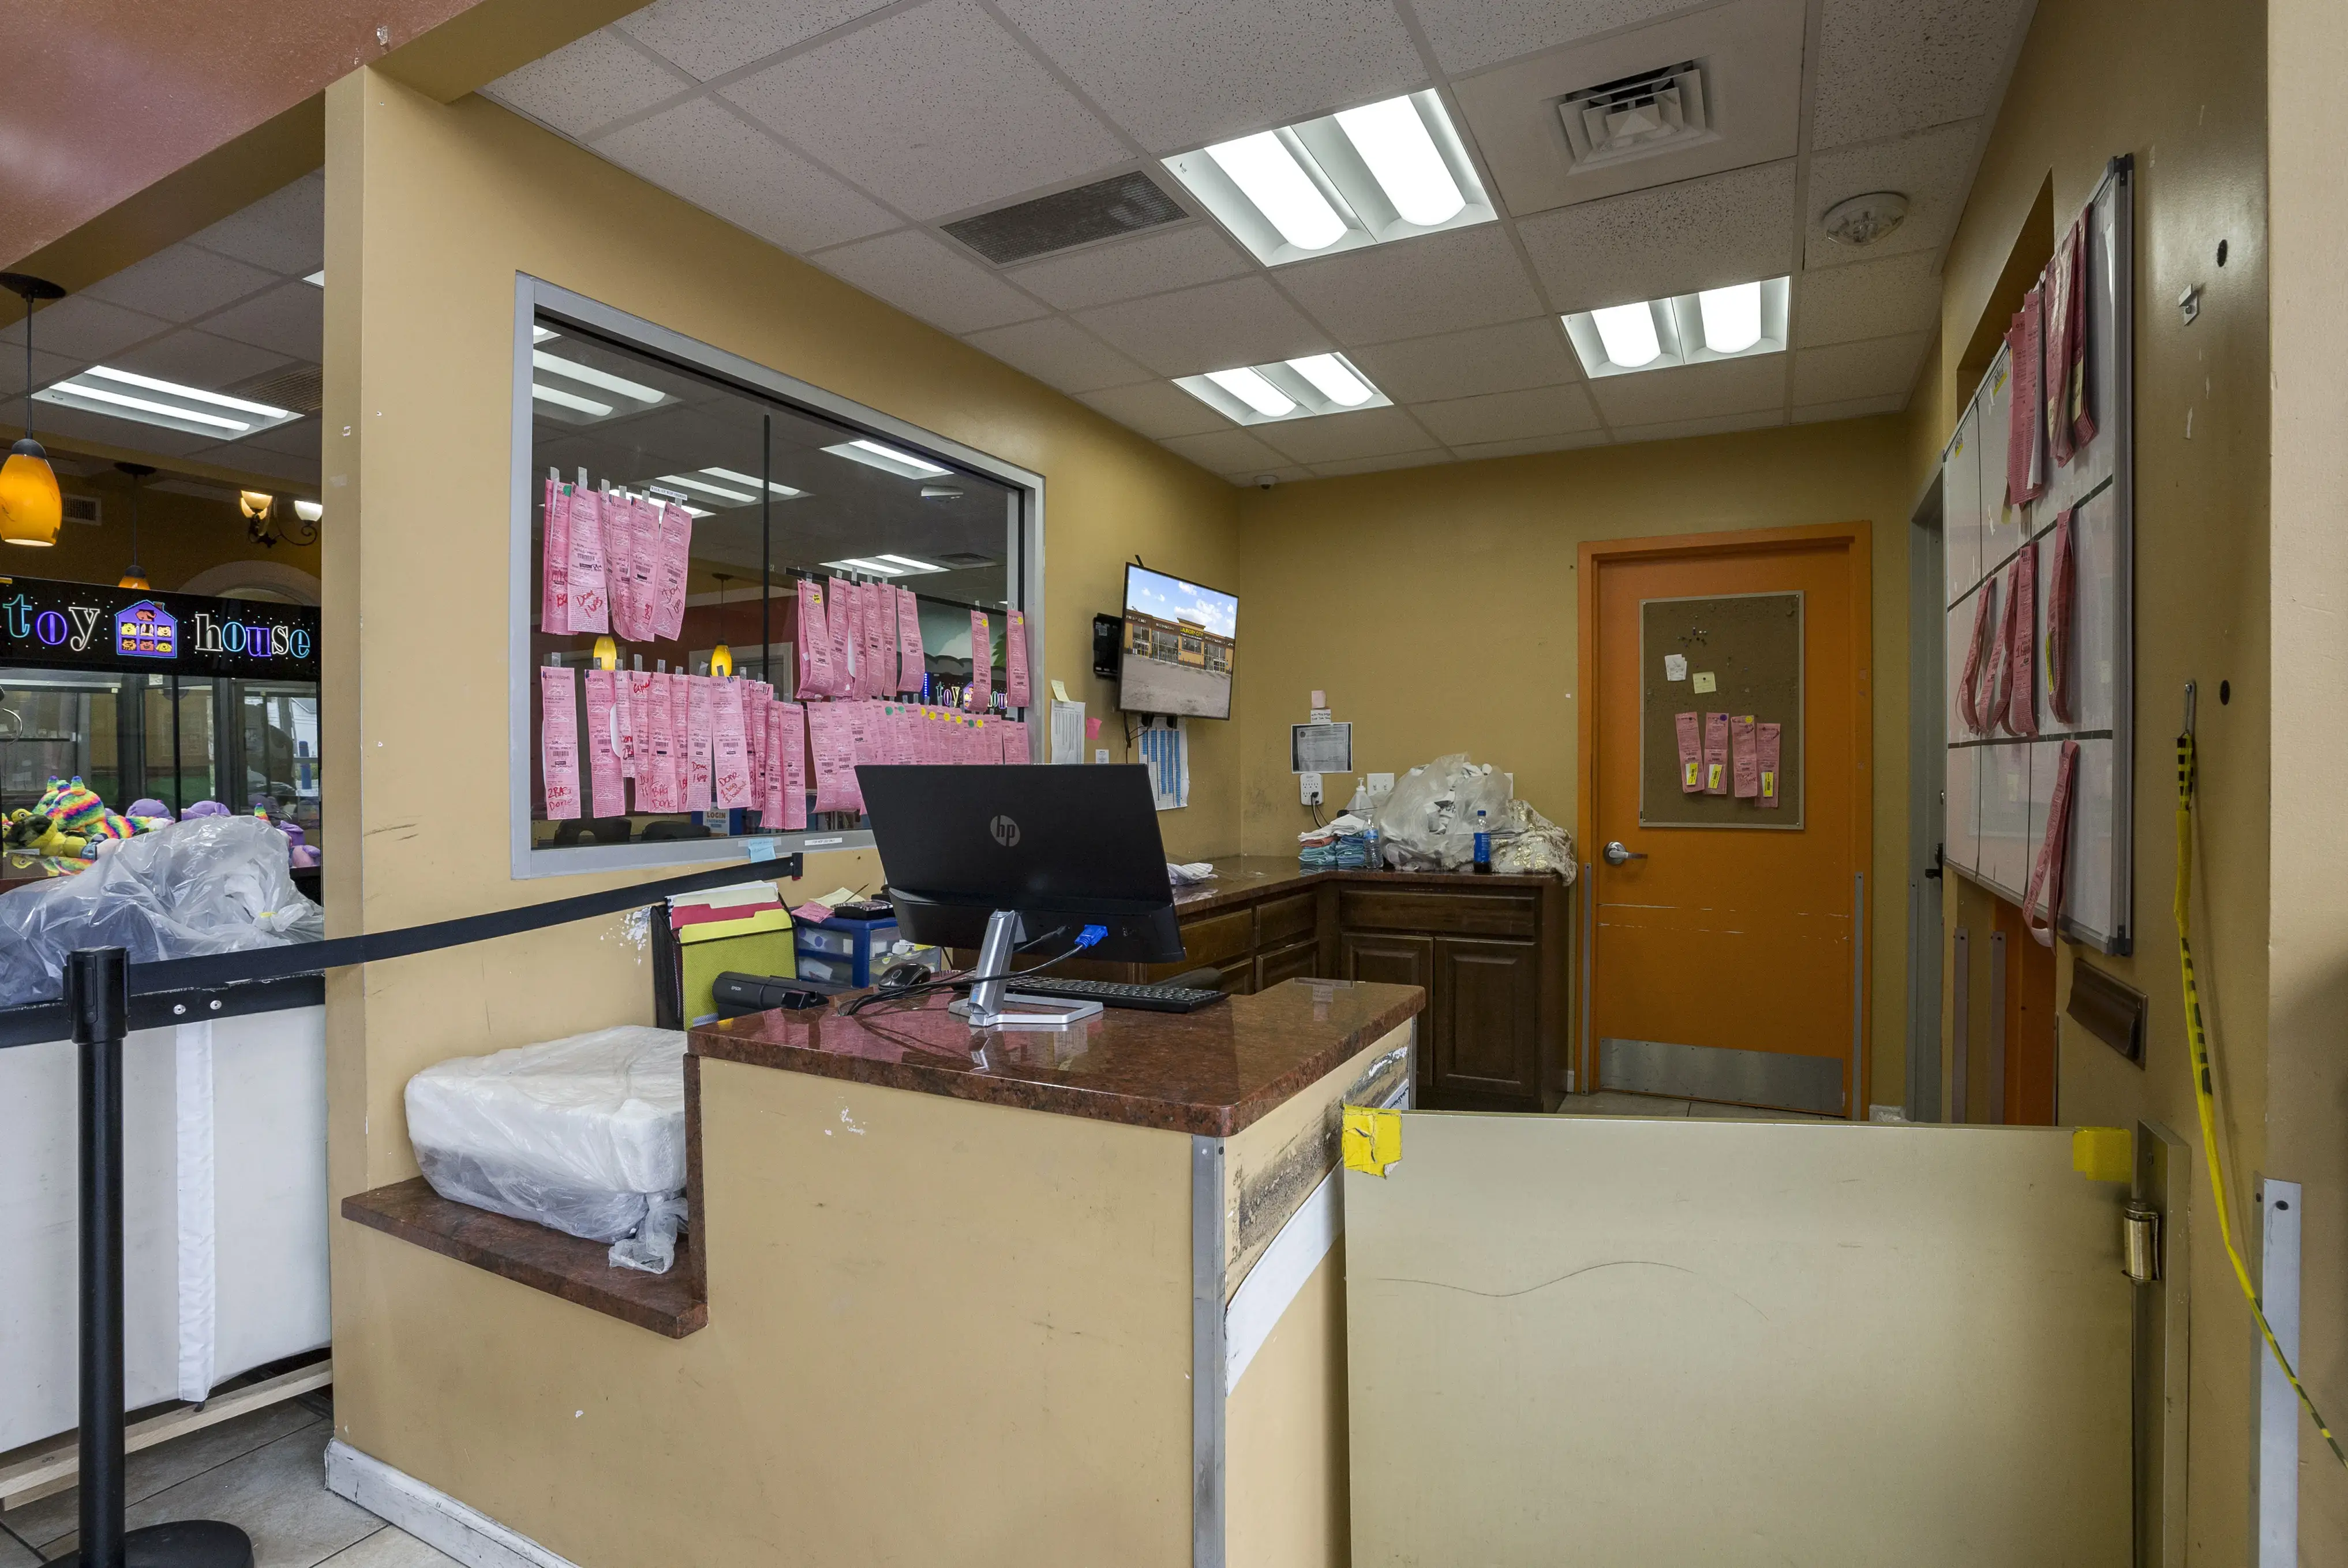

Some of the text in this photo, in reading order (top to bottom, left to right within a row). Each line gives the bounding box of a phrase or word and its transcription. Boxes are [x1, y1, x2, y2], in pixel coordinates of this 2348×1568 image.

[2, 594, 100, 651] toy
[195, 613, 311, 658] house
[935, 681, 960, 709] toy
[996, 815, 1016, 846] hp
